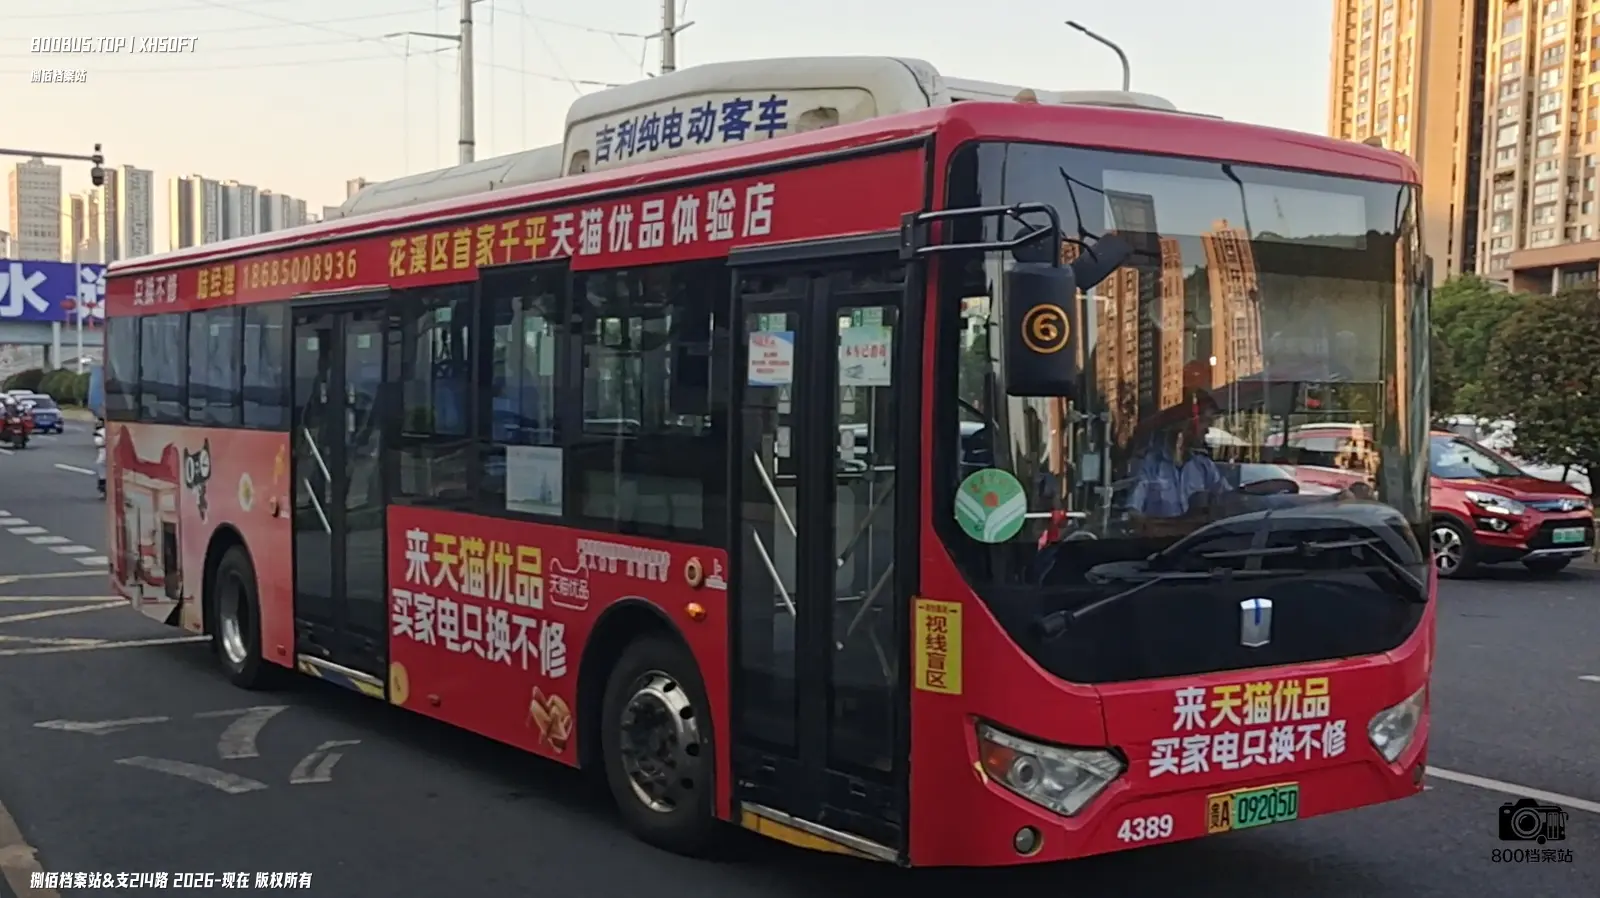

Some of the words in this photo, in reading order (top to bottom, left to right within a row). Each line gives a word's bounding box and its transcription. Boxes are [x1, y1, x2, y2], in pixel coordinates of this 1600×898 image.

[594, 94, 788, 165] 吉利纯电动客车
[387, 182, 776, 278] 花溪区首家千平天猫优品体验店
[243, 248, 358, 289] 18685008936
[1033, 313, 1058, 341] 6
[405, 527, 544, 610] 来天猫优品
[549, 574, 590, 600] 天猫优品
[392, 588, 567, 679] 买家电只换不修
[925, 614, 948, 689] 视线盲区
[1173, 677, 1330, 731] 来天猫优品
[1149, 720, 1347, 778] 买家电只换不修
[1117, 814, 1173, 843] 4389
